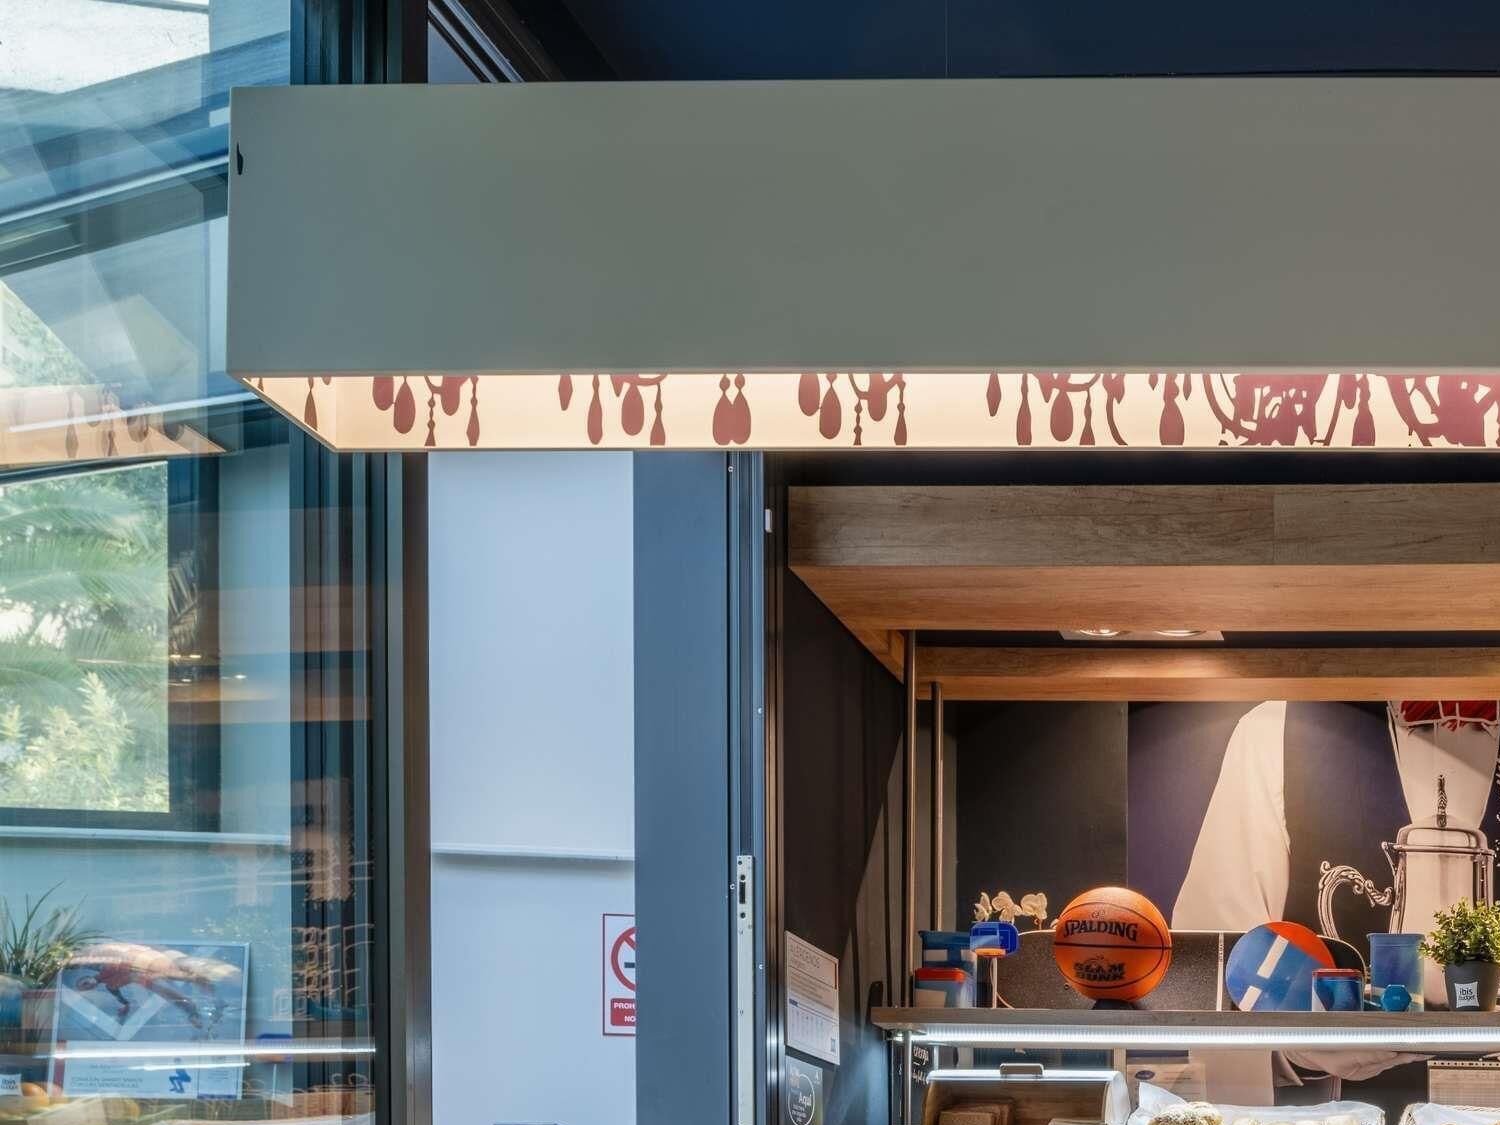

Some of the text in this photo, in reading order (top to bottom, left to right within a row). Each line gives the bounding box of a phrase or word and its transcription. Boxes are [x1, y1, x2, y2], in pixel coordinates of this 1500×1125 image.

[1064, 919, 1138, 941] SPALDING
[1074, 962, 1126, 974] SLAM
[1460, 987, 1473, 995] ibis
